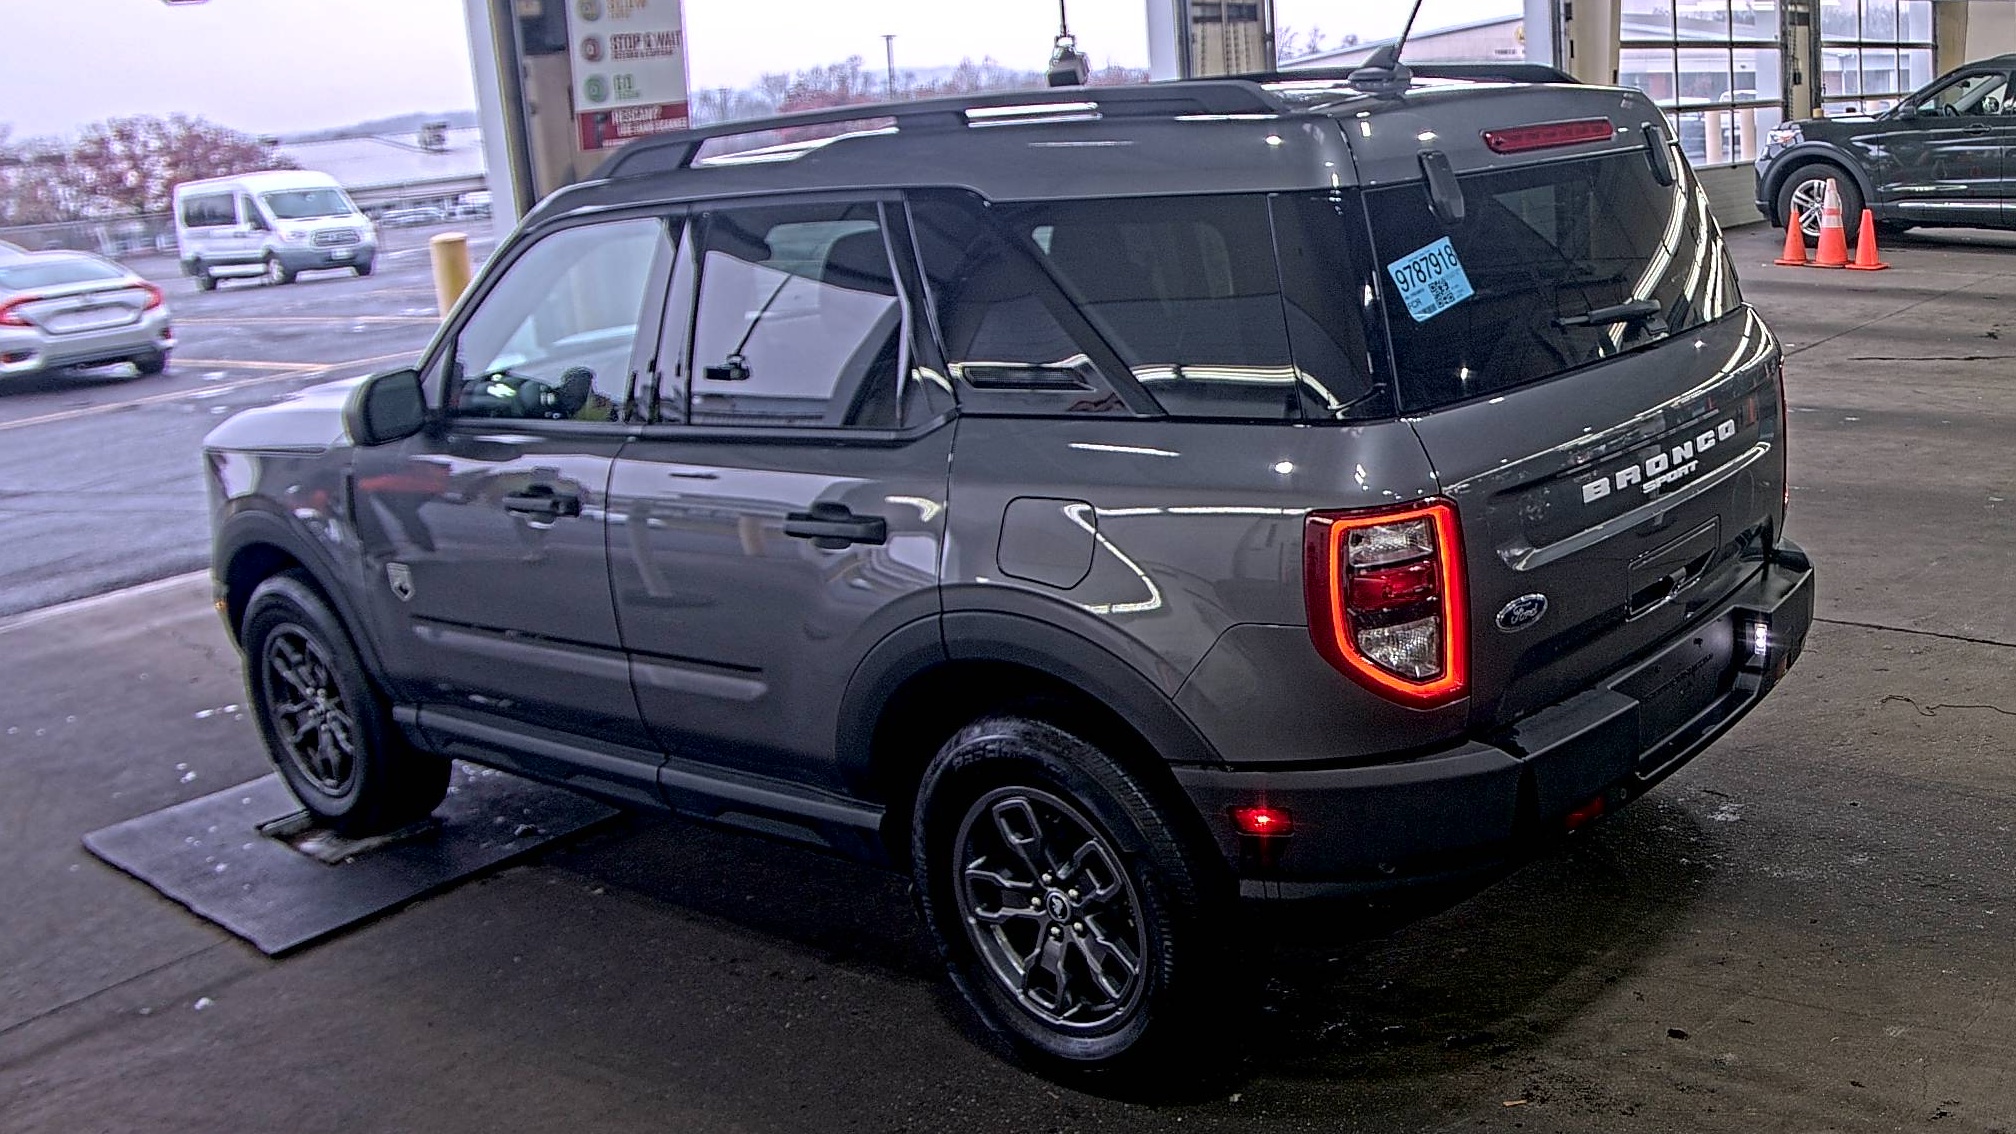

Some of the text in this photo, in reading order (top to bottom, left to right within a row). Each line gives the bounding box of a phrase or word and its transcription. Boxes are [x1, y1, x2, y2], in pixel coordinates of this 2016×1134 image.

[611, 33, 641, 49] STOP
[656, 30, 682, 47] WAIT
[1394, 244, 1458, 292] 9787918
[1582, 418, 1736, 504] BRONCO
[1642, 459, 1699, 495] SPORT
[1511, 601, 1538, 624] Ford
